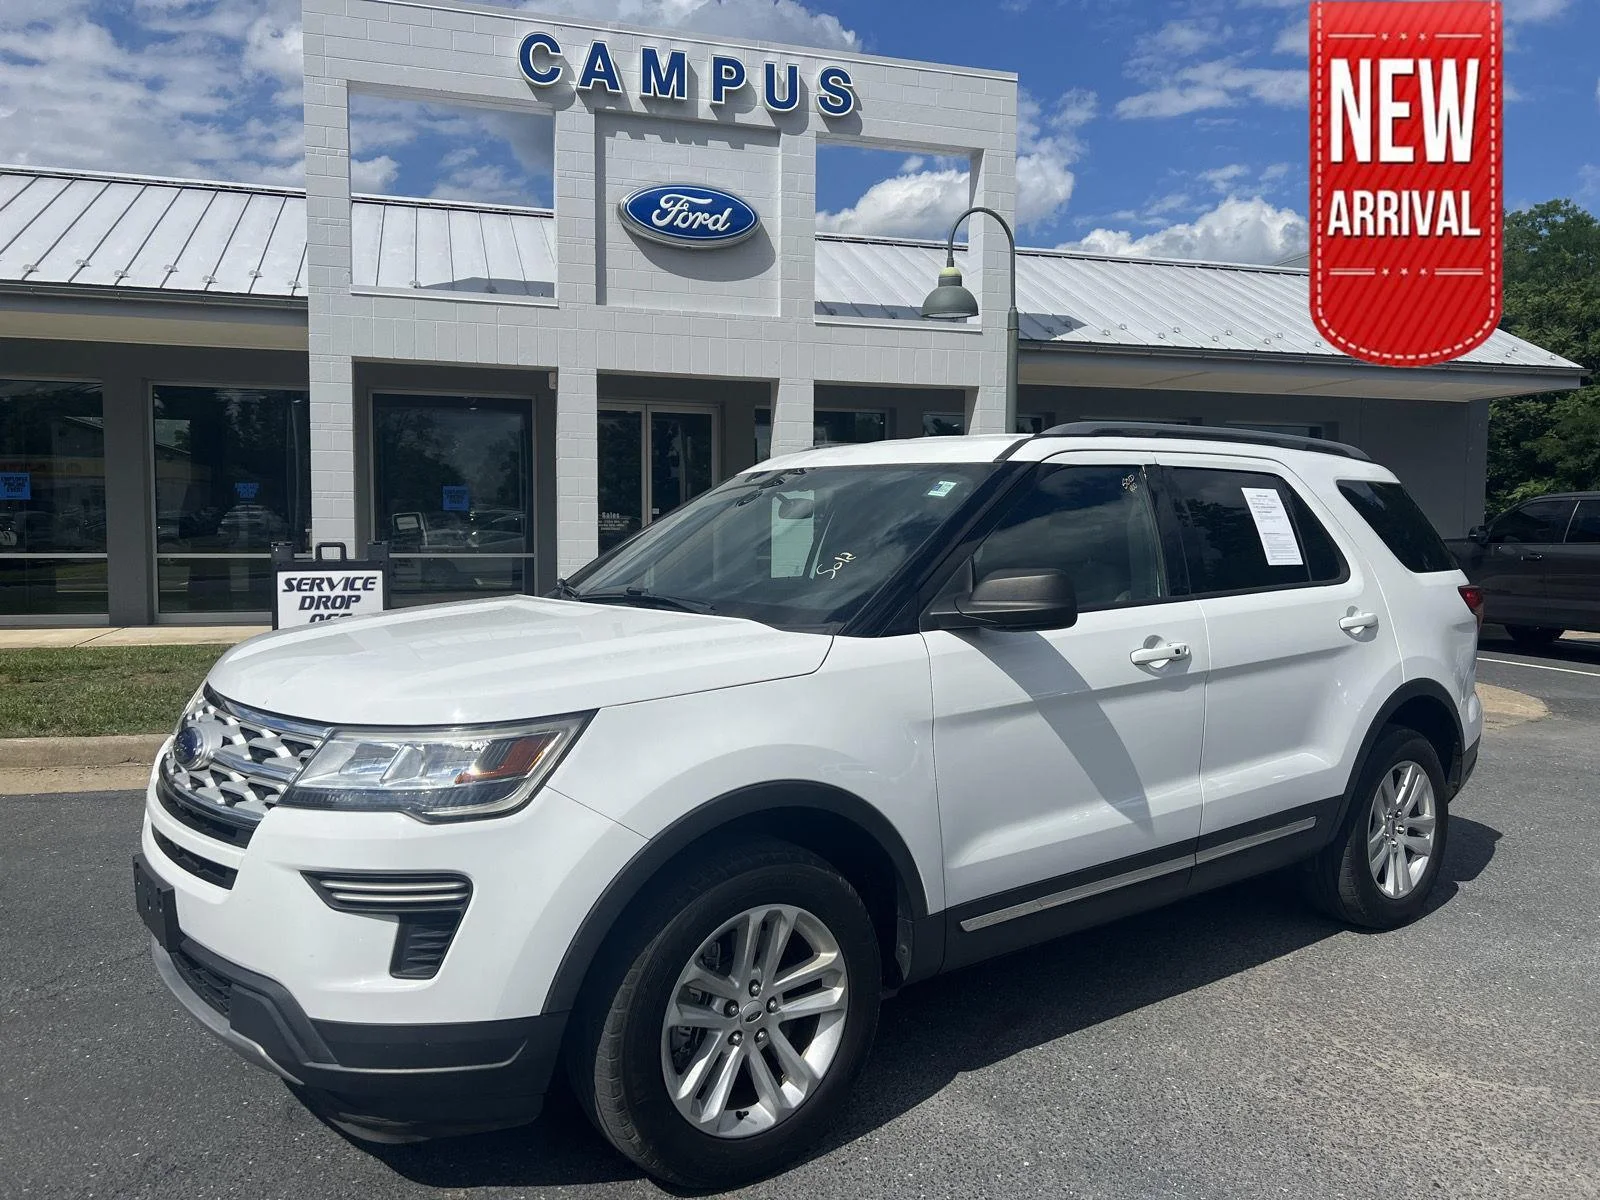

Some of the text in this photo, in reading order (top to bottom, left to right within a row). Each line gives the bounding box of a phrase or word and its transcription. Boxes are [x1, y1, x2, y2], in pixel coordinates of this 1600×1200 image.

[517, 31, 855, 117] CAMPUS
[651, 193, 733, 232] Ford
[601, 511, 620, 519] Sales
[281, 576, 378, 593] SERVICE
[298, 594, 362, 611] DROP
